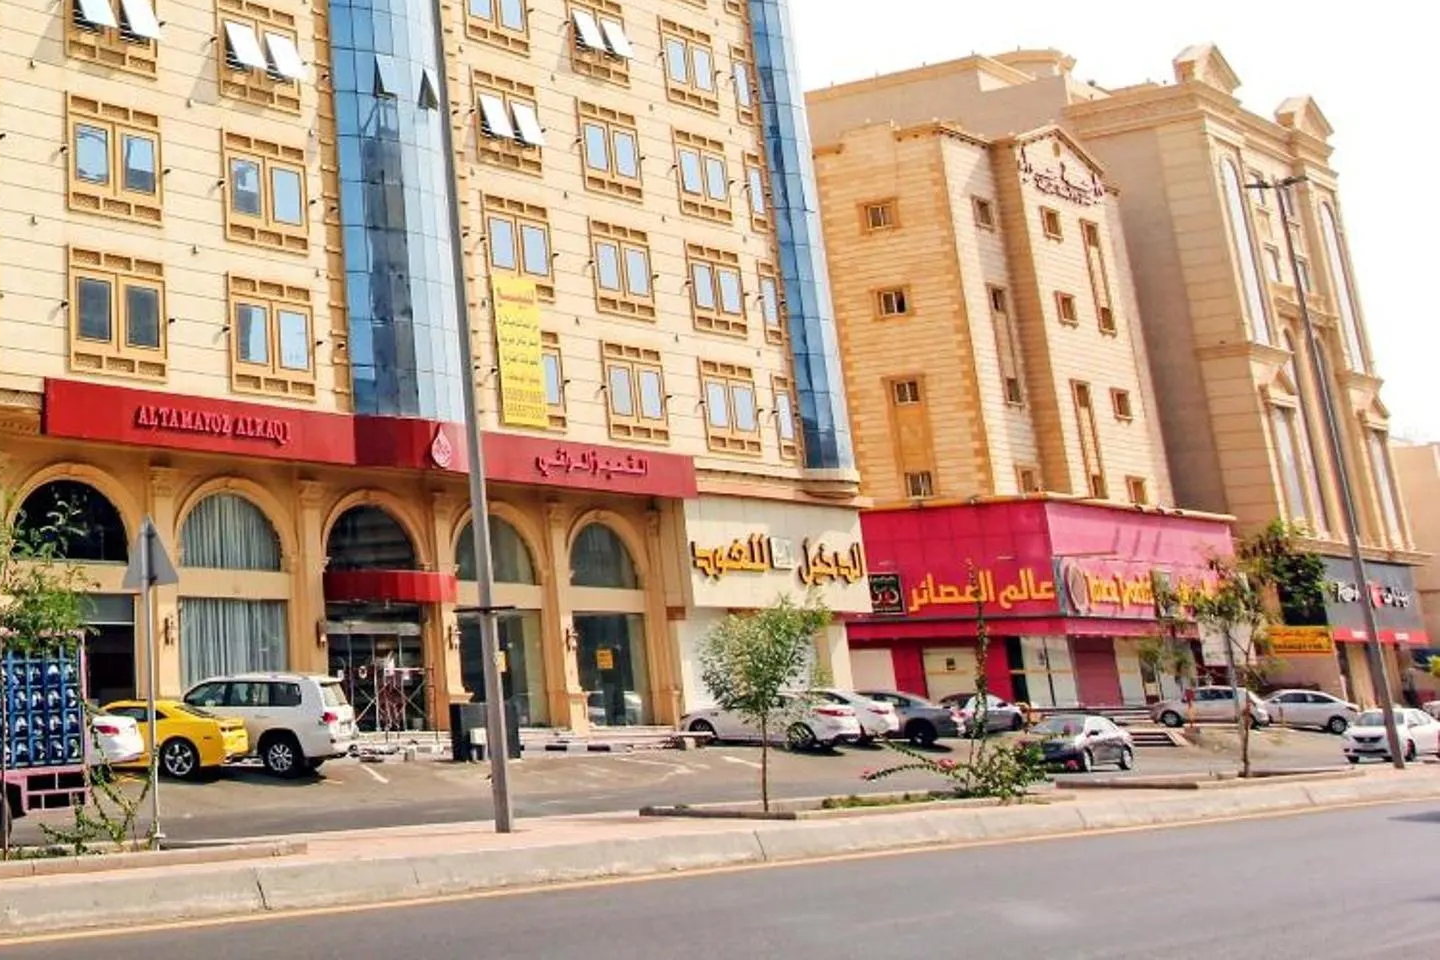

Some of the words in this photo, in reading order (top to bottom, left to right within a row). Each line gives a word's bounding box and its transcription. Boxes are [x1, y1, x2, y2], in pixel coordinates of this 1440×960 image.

[236, 416, 291, 444] ALRAQI
[907, 569, 995, 612] العصائر
[1000, 567, 1055, 609] عالم
